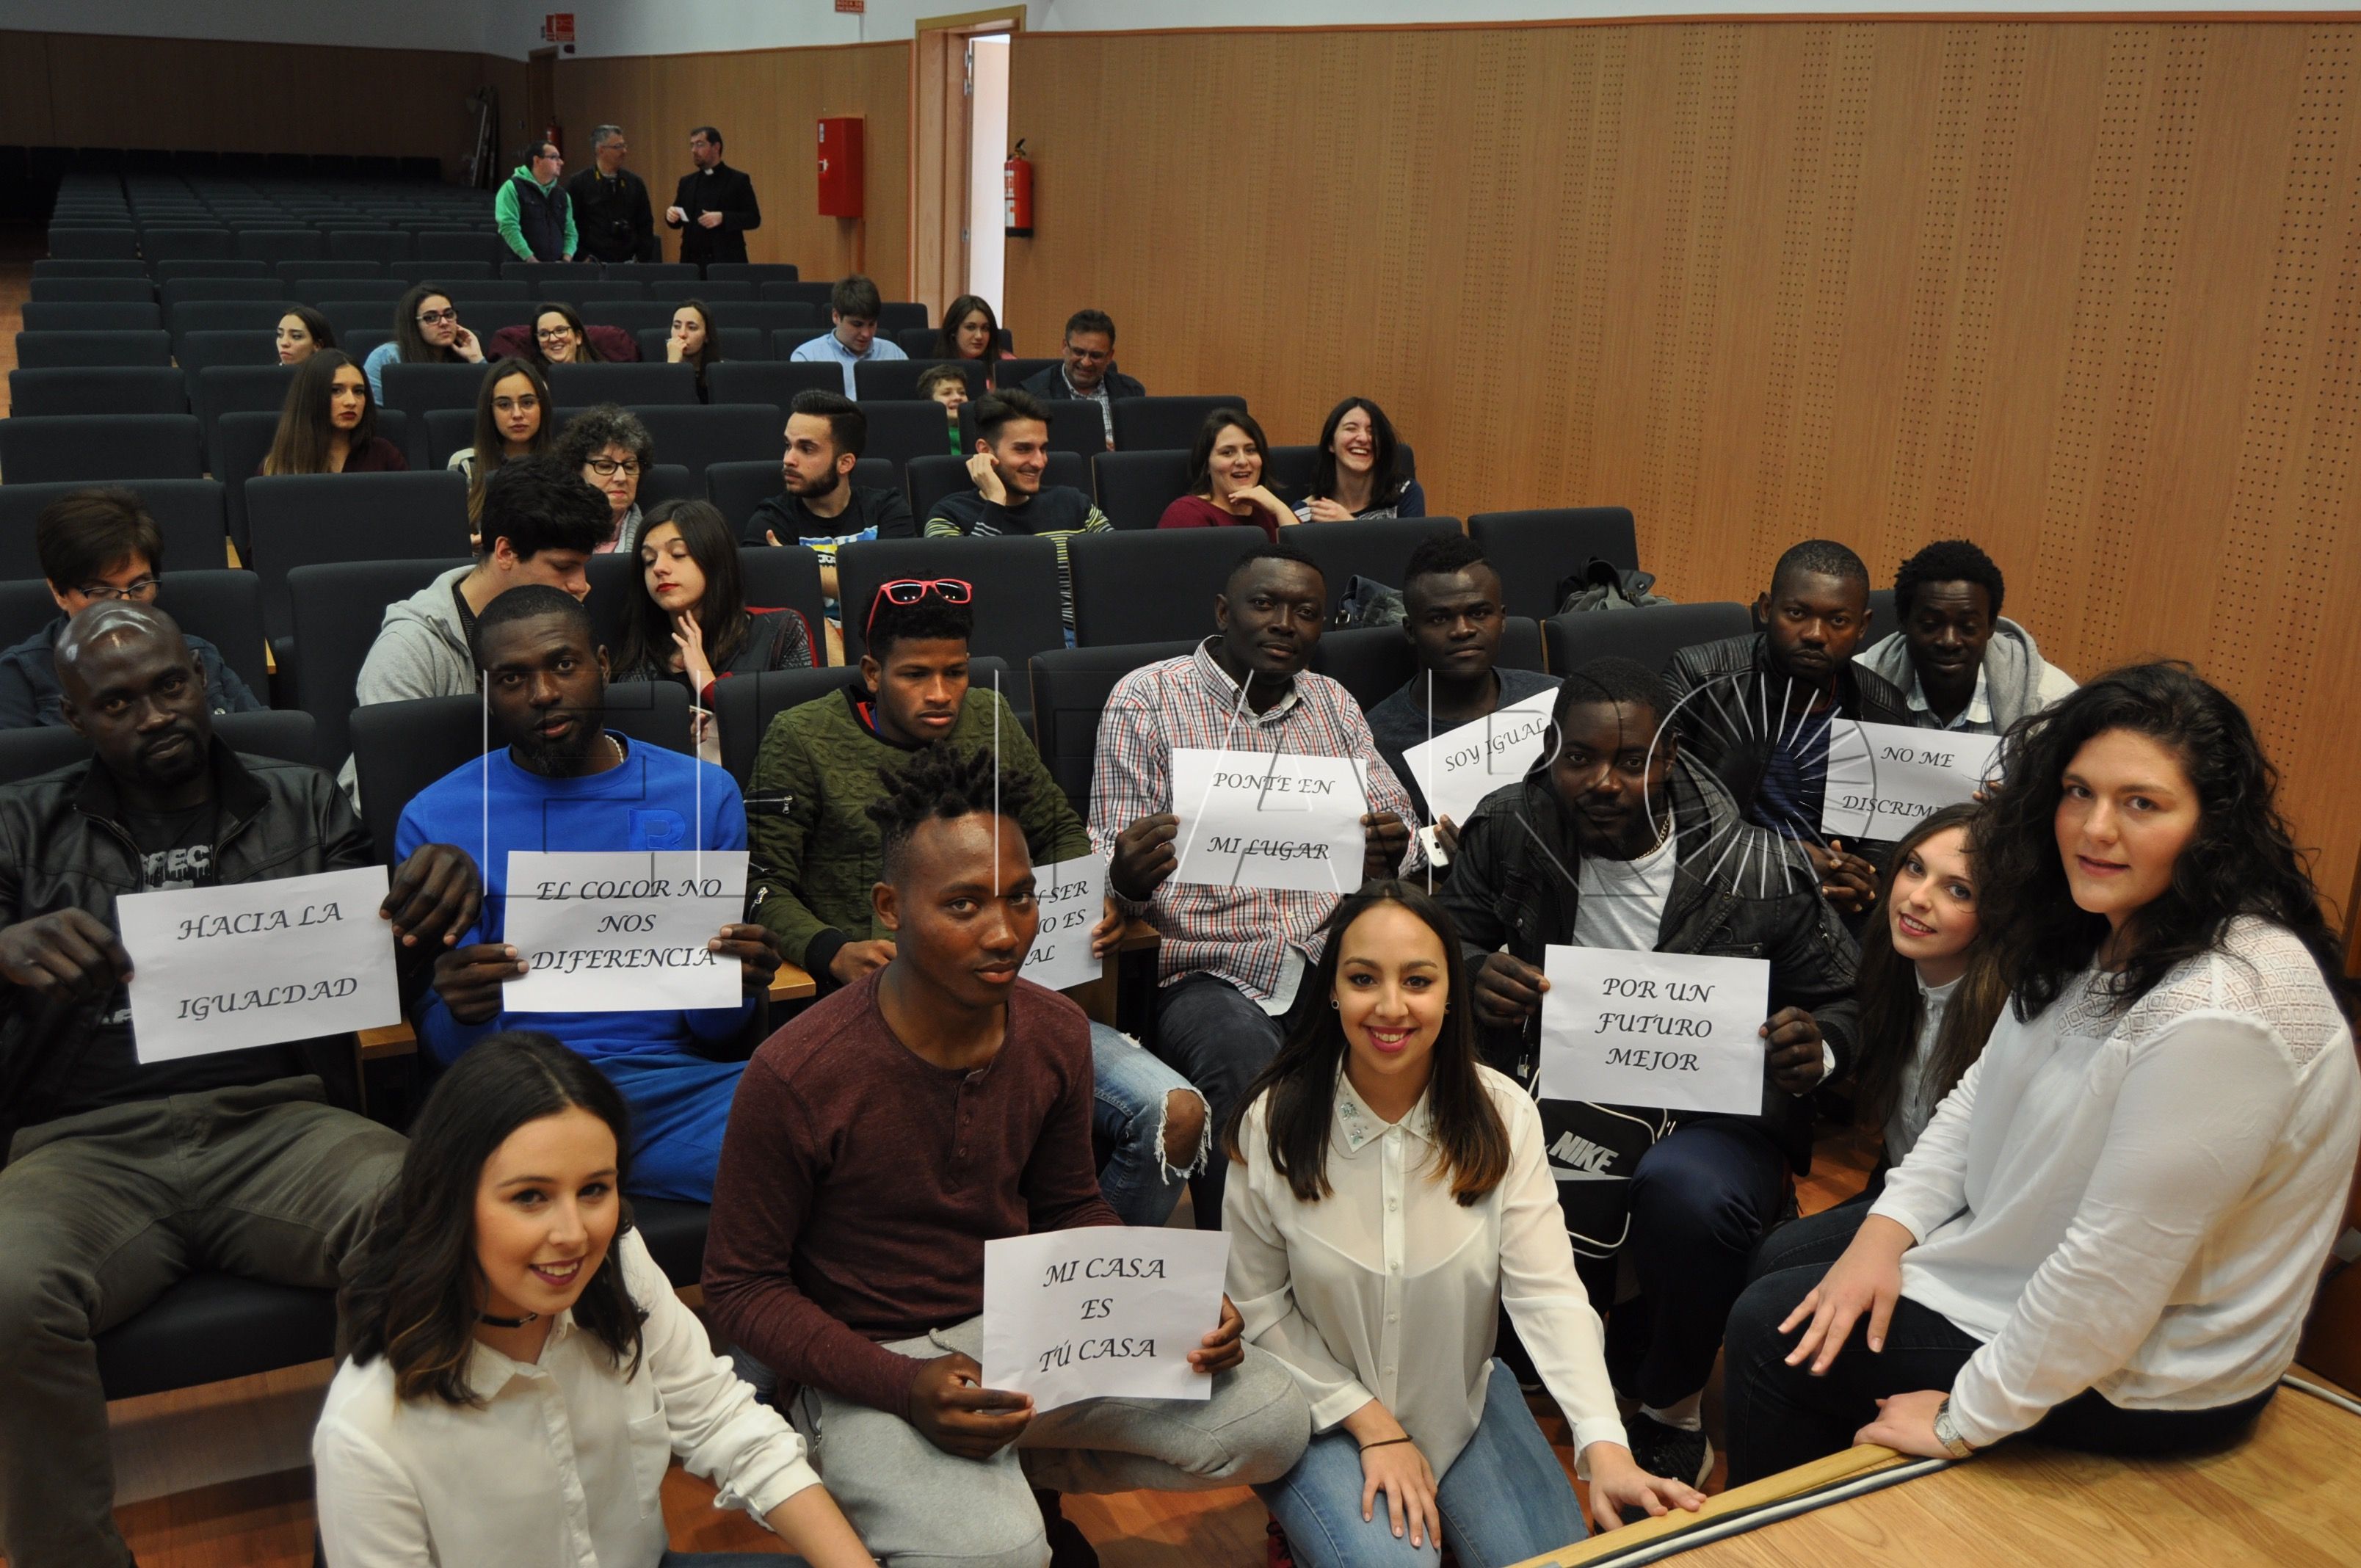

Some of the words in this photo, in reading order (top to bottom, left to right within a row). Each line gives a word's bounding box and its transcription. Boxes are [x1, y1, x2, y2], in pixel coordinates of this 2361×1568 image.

[1445, 744, 1481, 772] SOY
[1484, 718, 1547, 755] IGUAL
[1880, 746, 1914, 763] NO
[1918, 751, 1956, 768] ME
[1212, 772, 1292, 792] PONTE
[1298, 778, 1335, 795] EN
[1842, 795, 1945, 818] DISCRIM
[1207, 836, 1242, 854] MI
[1244, 839, 1331, 861] LUGAR
[536, 882, 571, 901] EL
[580, 879, 672, 900] COLOR
[677, 879, 722, 898] NO
[1048, 880, 1089, 904] SER
[177, 910, 291, 940] HACIA
[297, 902, 344, 926] LA
[597, 914, 657, 933] NOS
[1062, 908, 1087, 929] ES
[531, 947, 717, 974] DIFERENCIA
[177, 977, 358, 1021] IGUALDAD
[1602, 978, 1658, 999] POR
[1664, 982, 1716, 1003] UN
[1594, 1012, 1713, 1038] FUTURO
[1605, 1048, 1700, 1072] MEJOR
[1548, 1130, 1620, 1175] NIKE
[1042, 1260, 1080, 1288] MI
[1085, 1257, 1167, 1279] CASA
[1081, 1298, 1114, 1321] ES
[1038, 1339, 1072, 1373] TÚ
[1078, 1337, 1157, 1361] CASA
